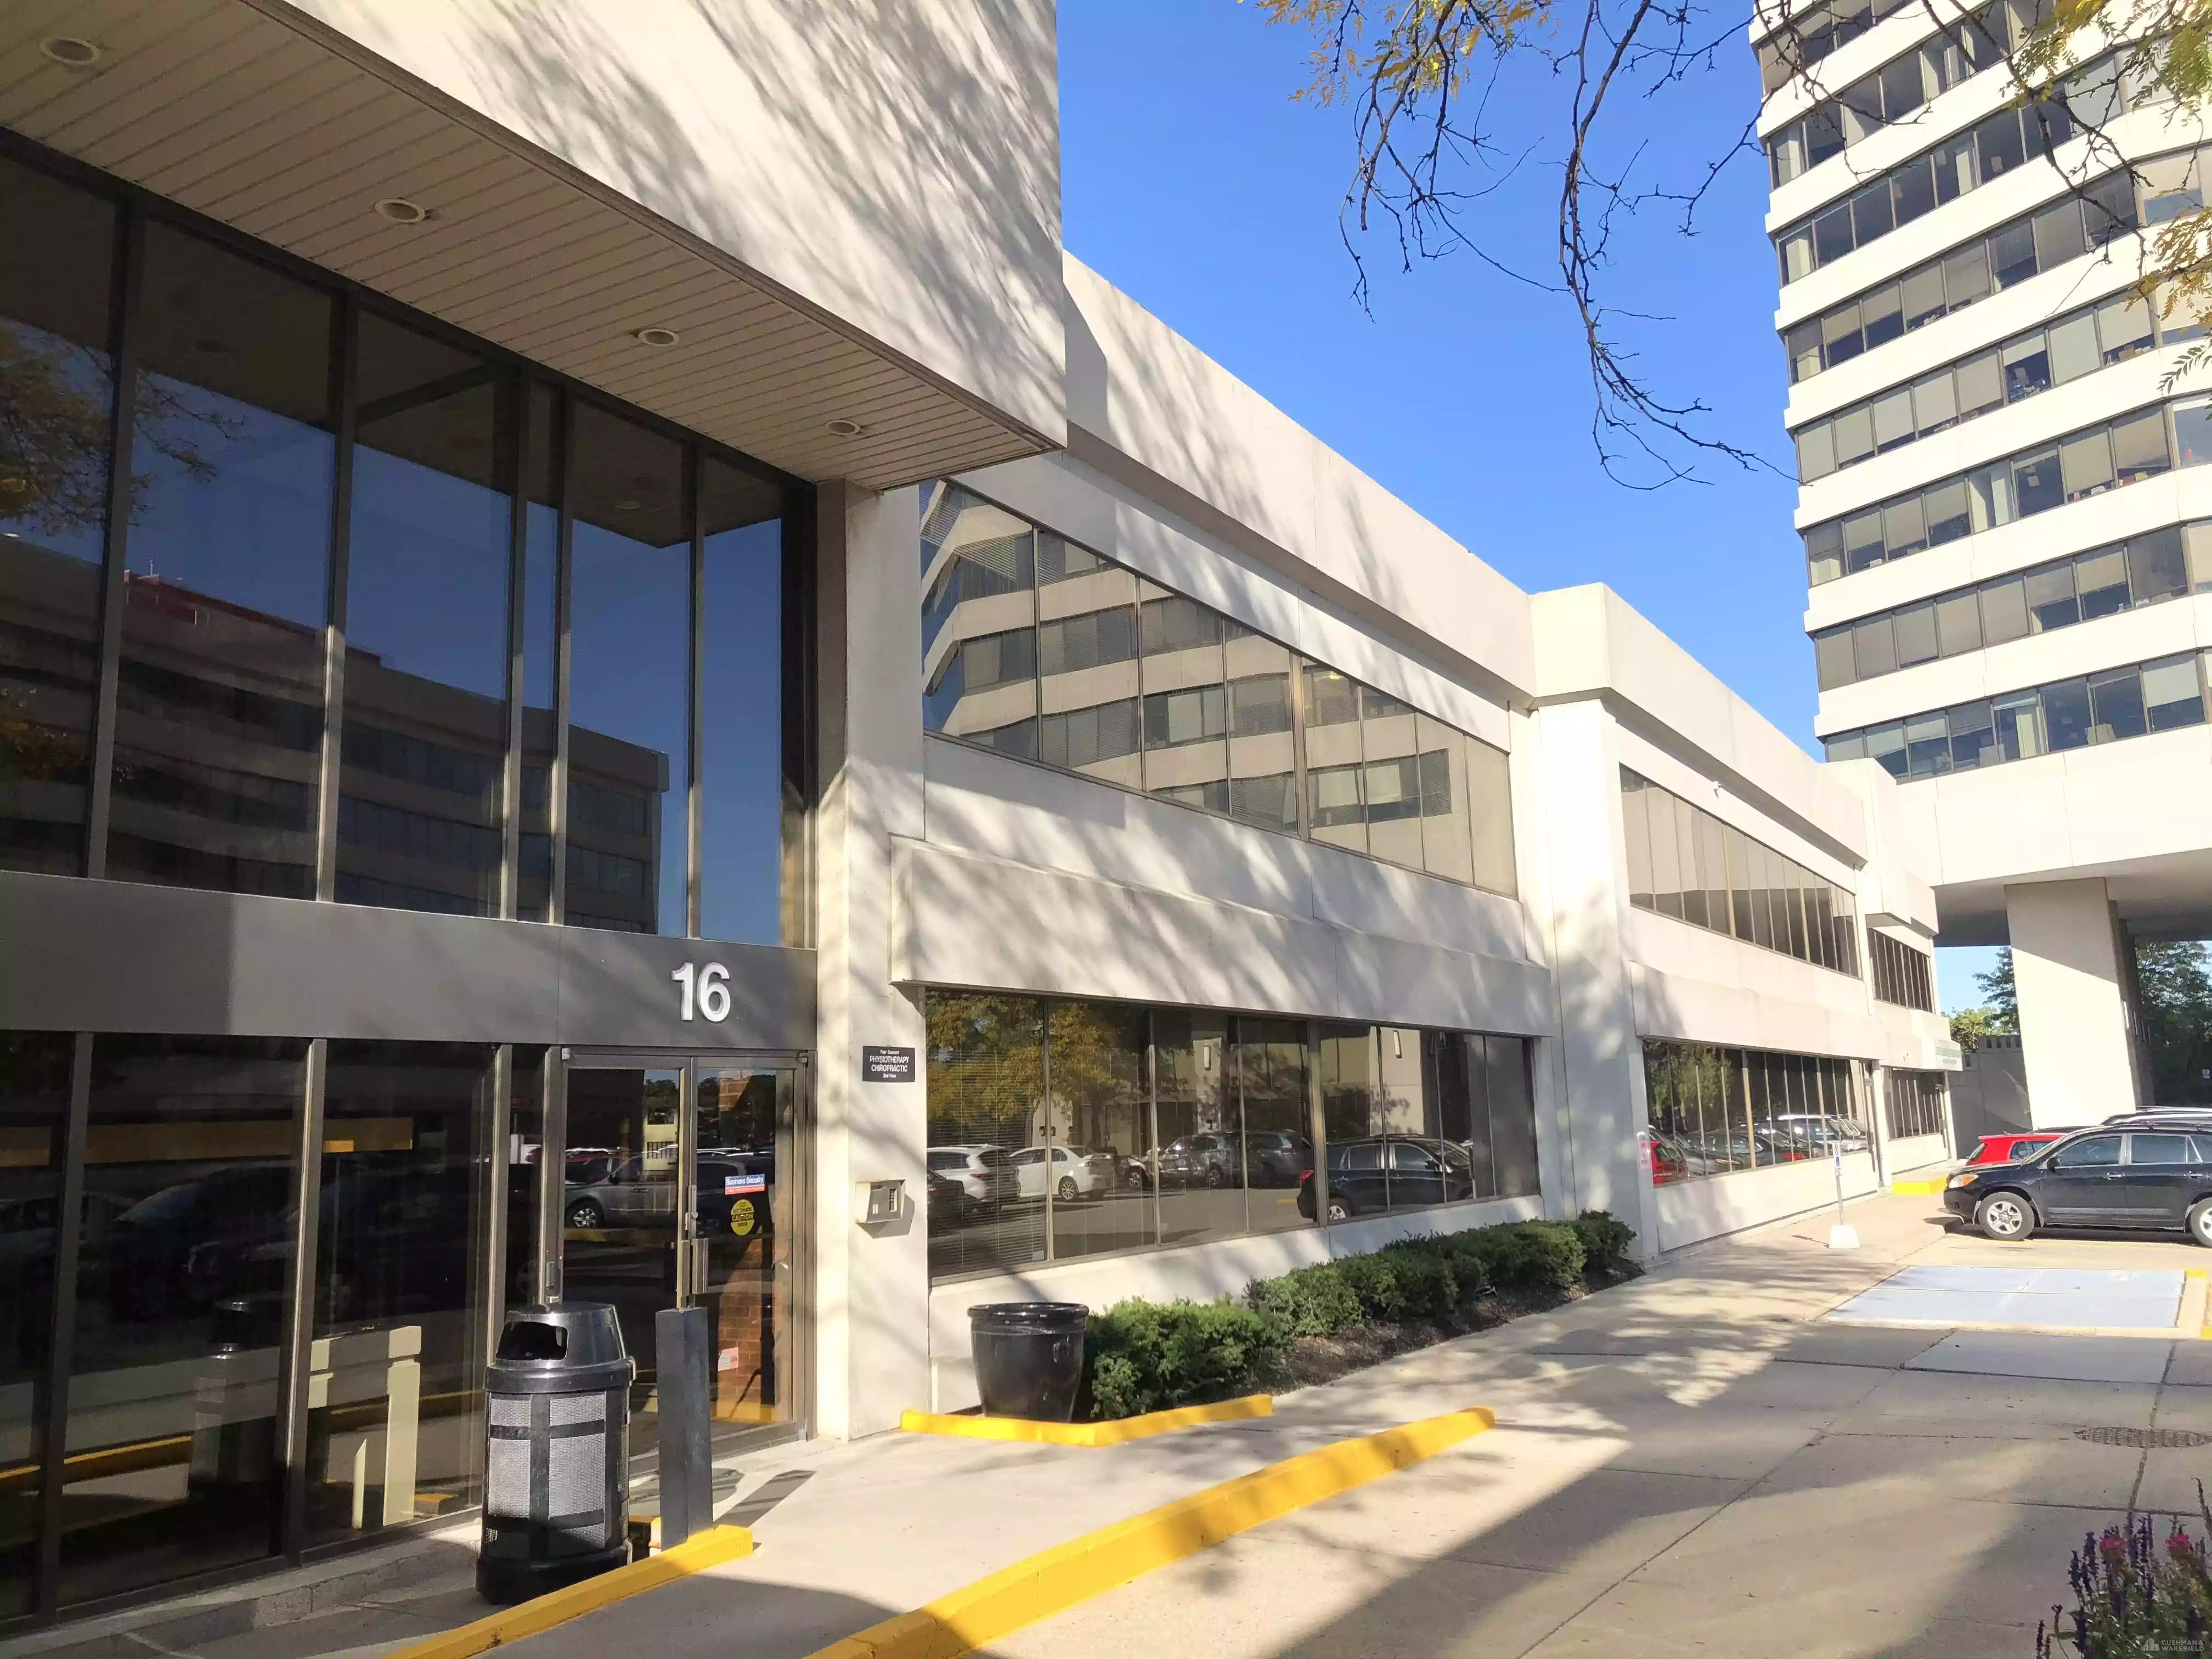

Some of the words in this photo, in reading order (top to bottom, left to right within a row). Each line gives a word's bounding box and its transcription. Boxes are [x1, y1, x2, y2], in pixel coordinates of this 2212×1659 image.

[672, 962, 731, 1022] 16
[870, 1055, 910, 1063] PHYSIOTHERAPY
[746, 1176, 764, 1184] Security
[732, 1213, 753, 1221] CAUTION
